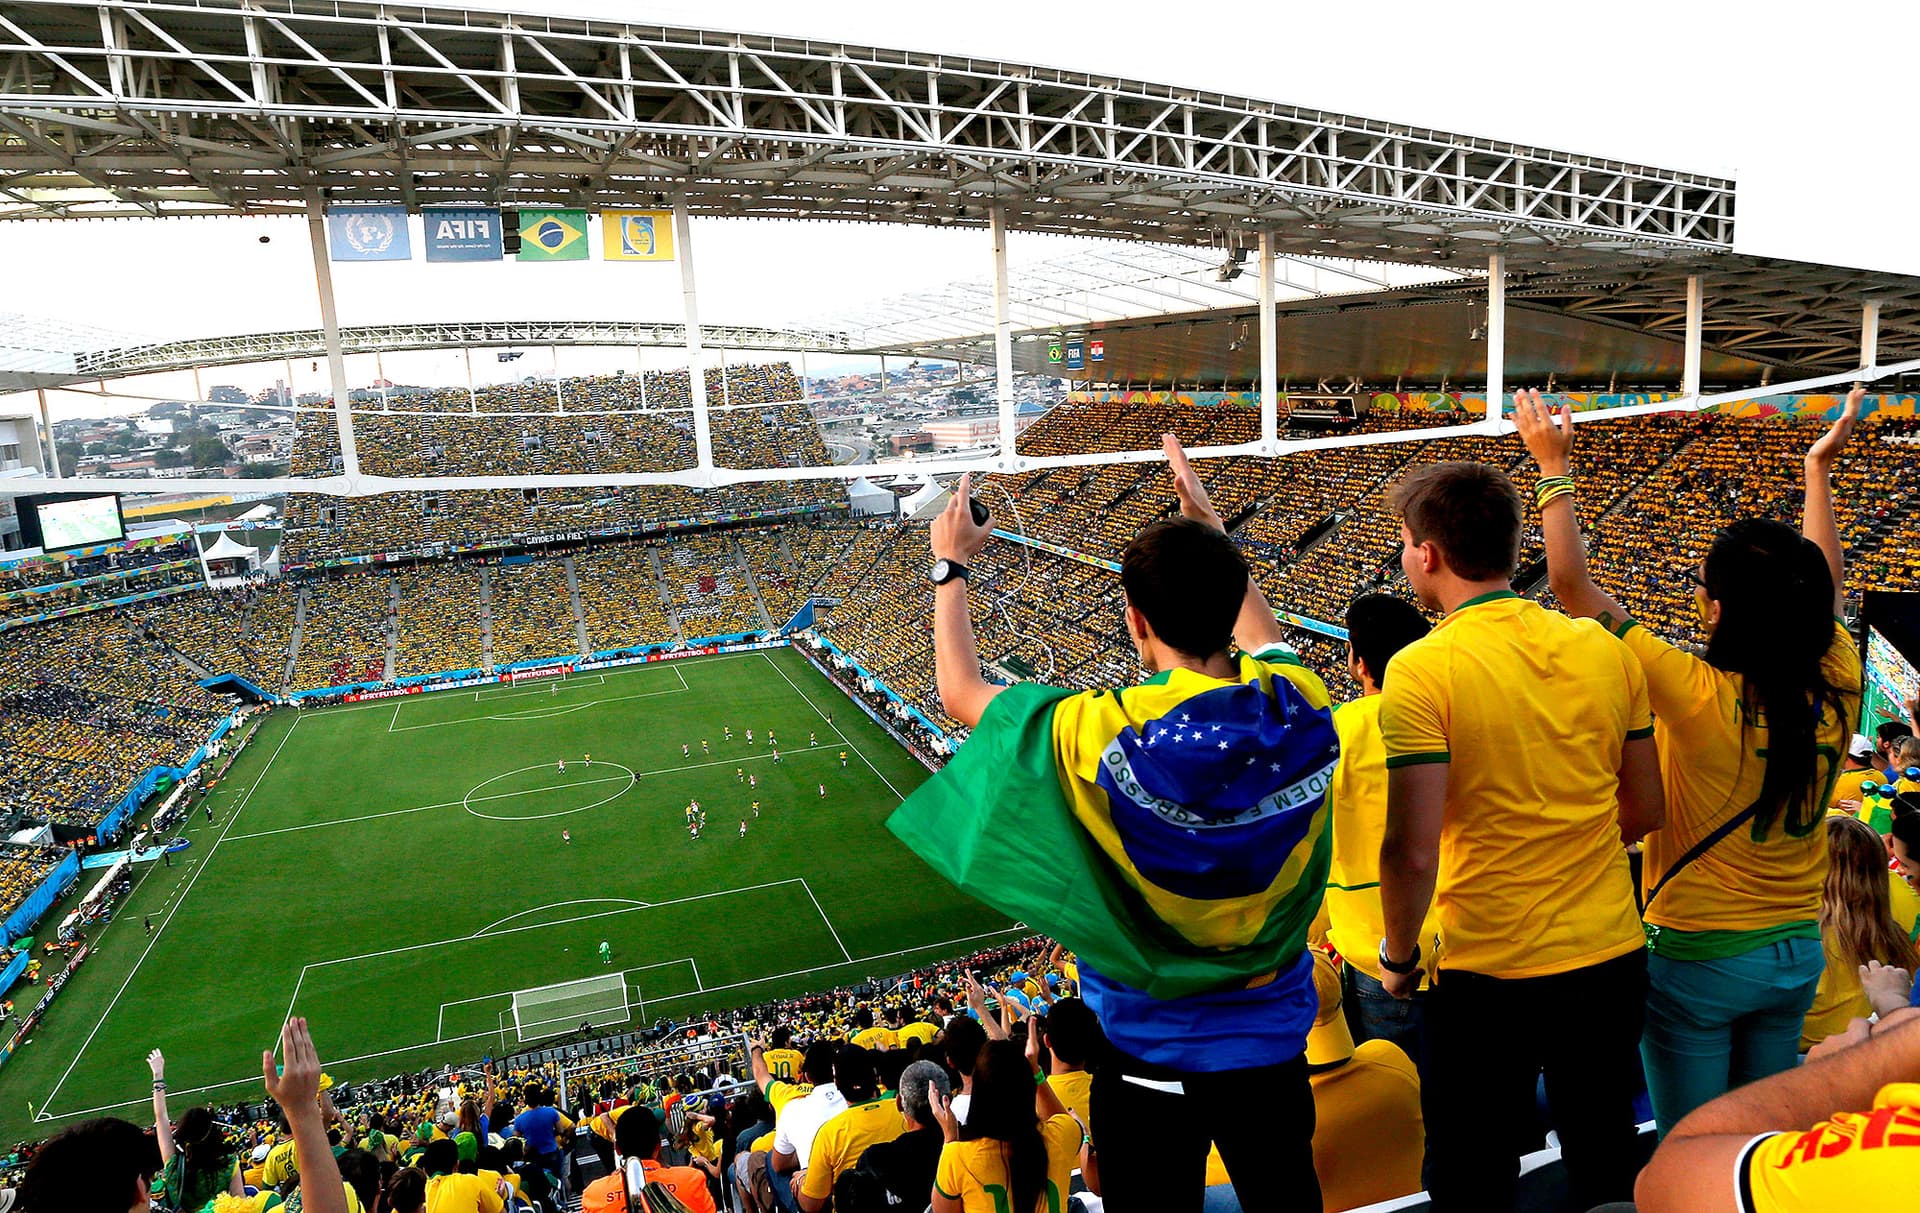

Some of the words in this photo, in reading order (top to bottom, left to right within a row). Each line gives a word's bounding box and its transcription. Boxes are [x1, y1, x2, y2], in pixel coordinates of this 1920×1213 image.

[660, 649, 706, 660] #FRYFUTBOL
[359, 688, 410, 701] #FRYFUTBOL
[773, 1061, 791, 1079] 10
